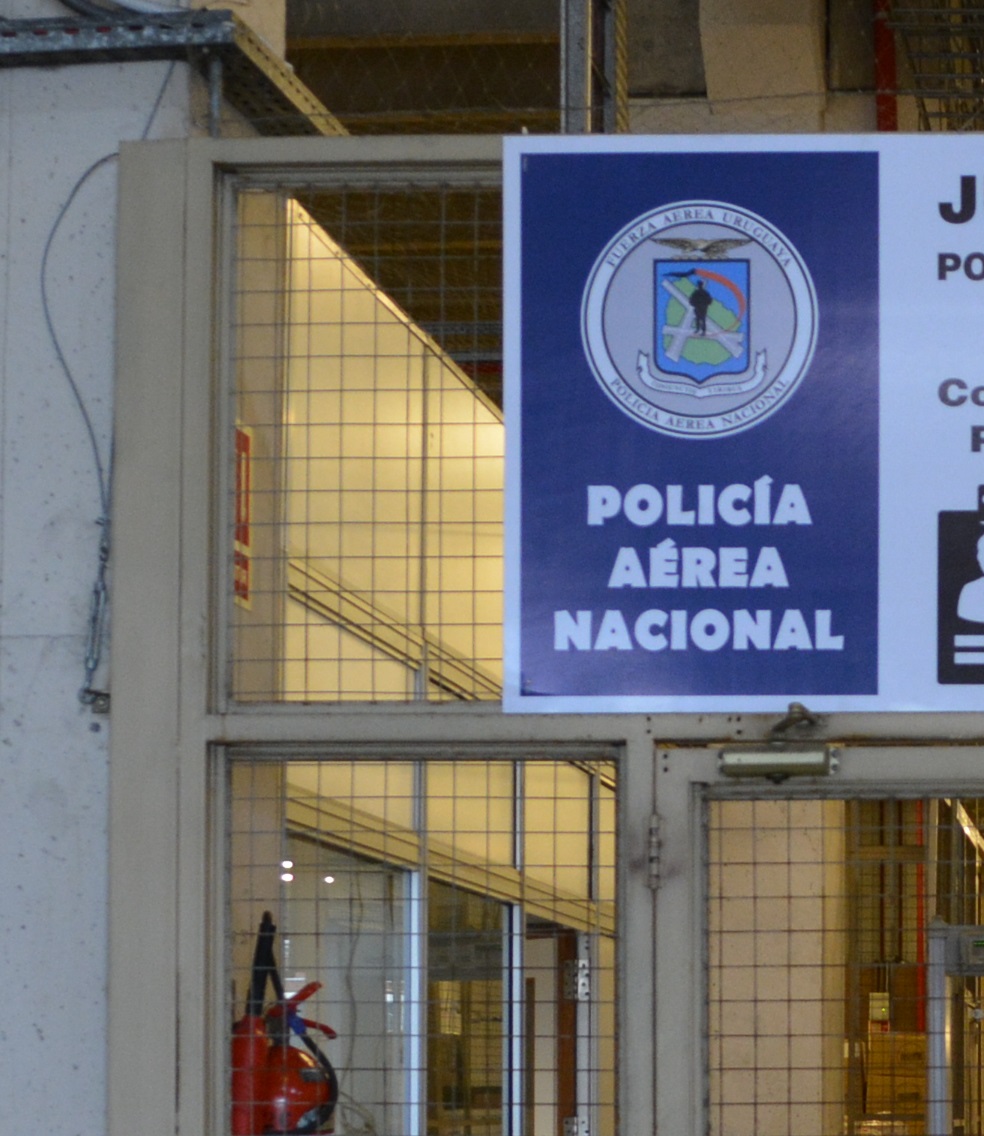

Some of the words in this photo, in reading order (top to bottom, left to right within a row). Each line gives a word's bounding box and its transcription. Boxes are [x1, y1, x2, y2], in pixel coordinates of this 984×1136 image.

[606, 221, 657, 267] FUERZA
[662, 207, 714, 225] AEREA
[722, 212, 792, 267] URUGUAYA
[721, 379, 790, 428] NACIONAL
[587, 475, 813, 527] POLICÍA
[608, 538, 790, 588] AÉREA
[554, 609, 846, 652] NACIONAL
